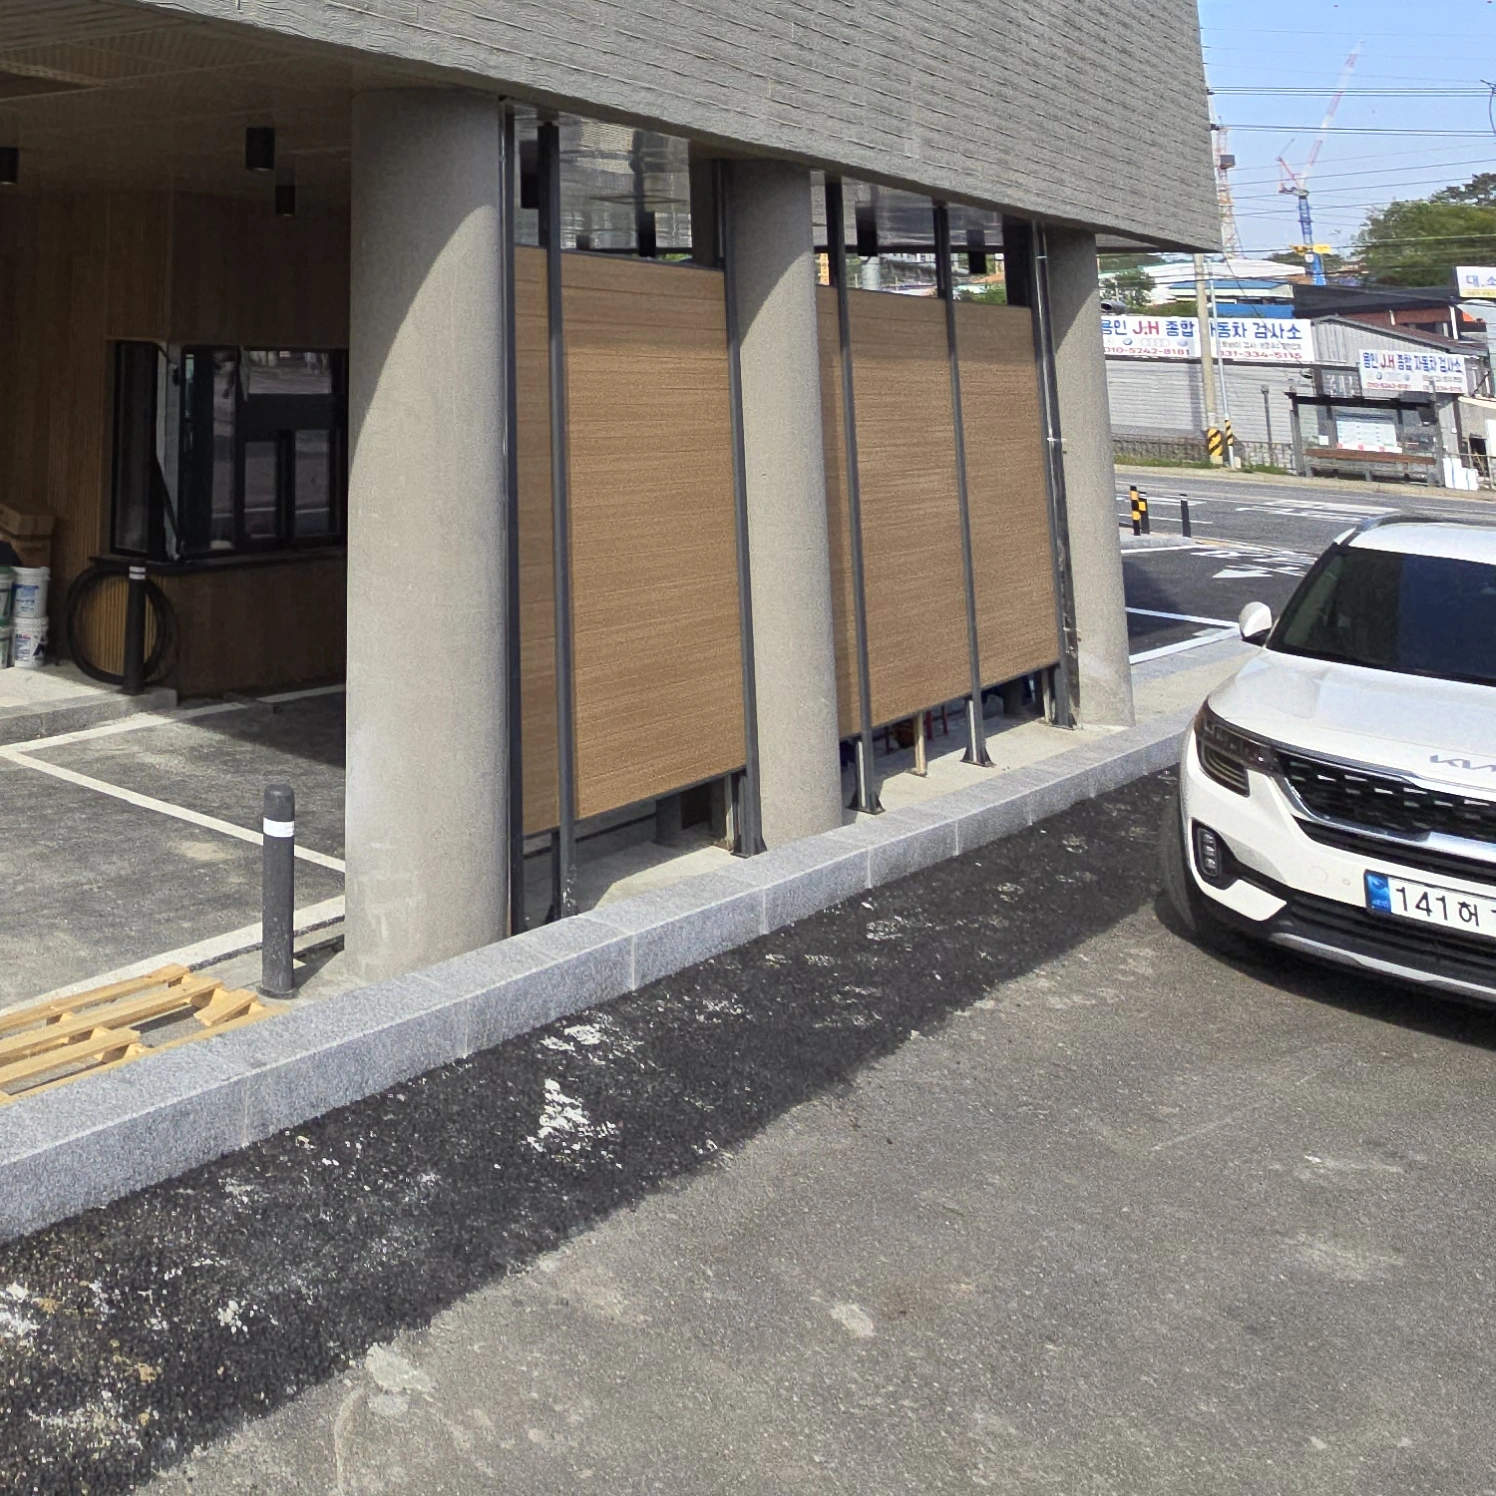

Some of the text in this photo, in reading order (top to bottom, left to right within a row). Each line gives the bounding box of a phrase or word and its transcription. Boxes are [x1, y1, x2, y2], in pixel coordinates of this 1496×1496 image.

[1101, 319, 1128, 335] 용인
[1132, 320, 1160, 336] J.H
[1165, 320, 1195, 338] 종합
[1252, 322, 1303, 340] 검사소
[1362, 351, 1379, 369] 용인
[1397, 353, 1412, 371] 종합
[1413, 354, 1438, 372] 자동차
[1438, 356, 1463, 373] 검사소
[1395, 886, 1480, 927] 141허
